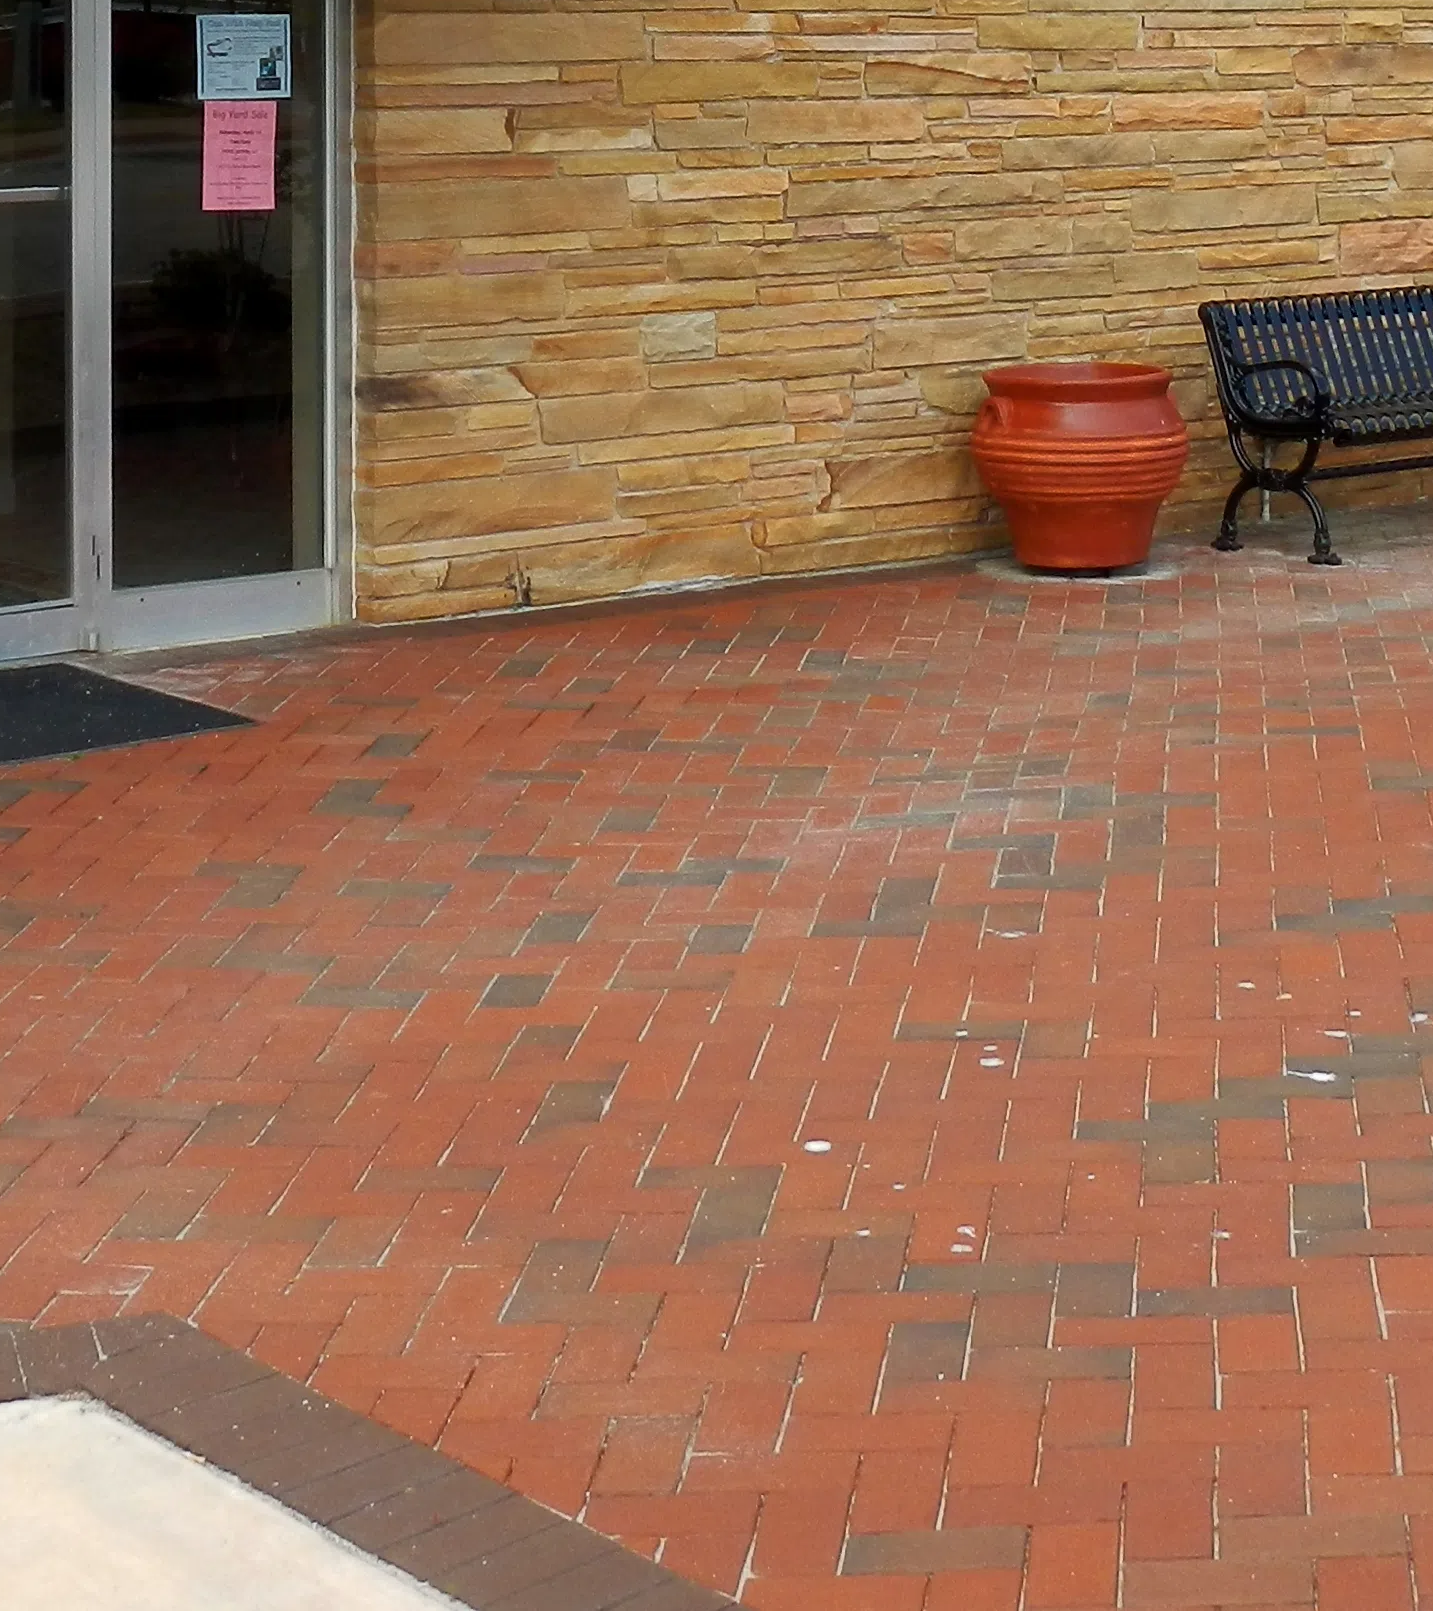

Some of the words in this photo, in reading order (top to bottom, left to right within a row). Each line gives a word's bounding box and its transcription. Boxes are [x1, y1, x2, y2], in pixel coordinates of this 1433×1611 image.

[212, 109, 226, 121] Big
[228, 109, 249, 119] Yard
[251, 109, 268, 119] Sale
